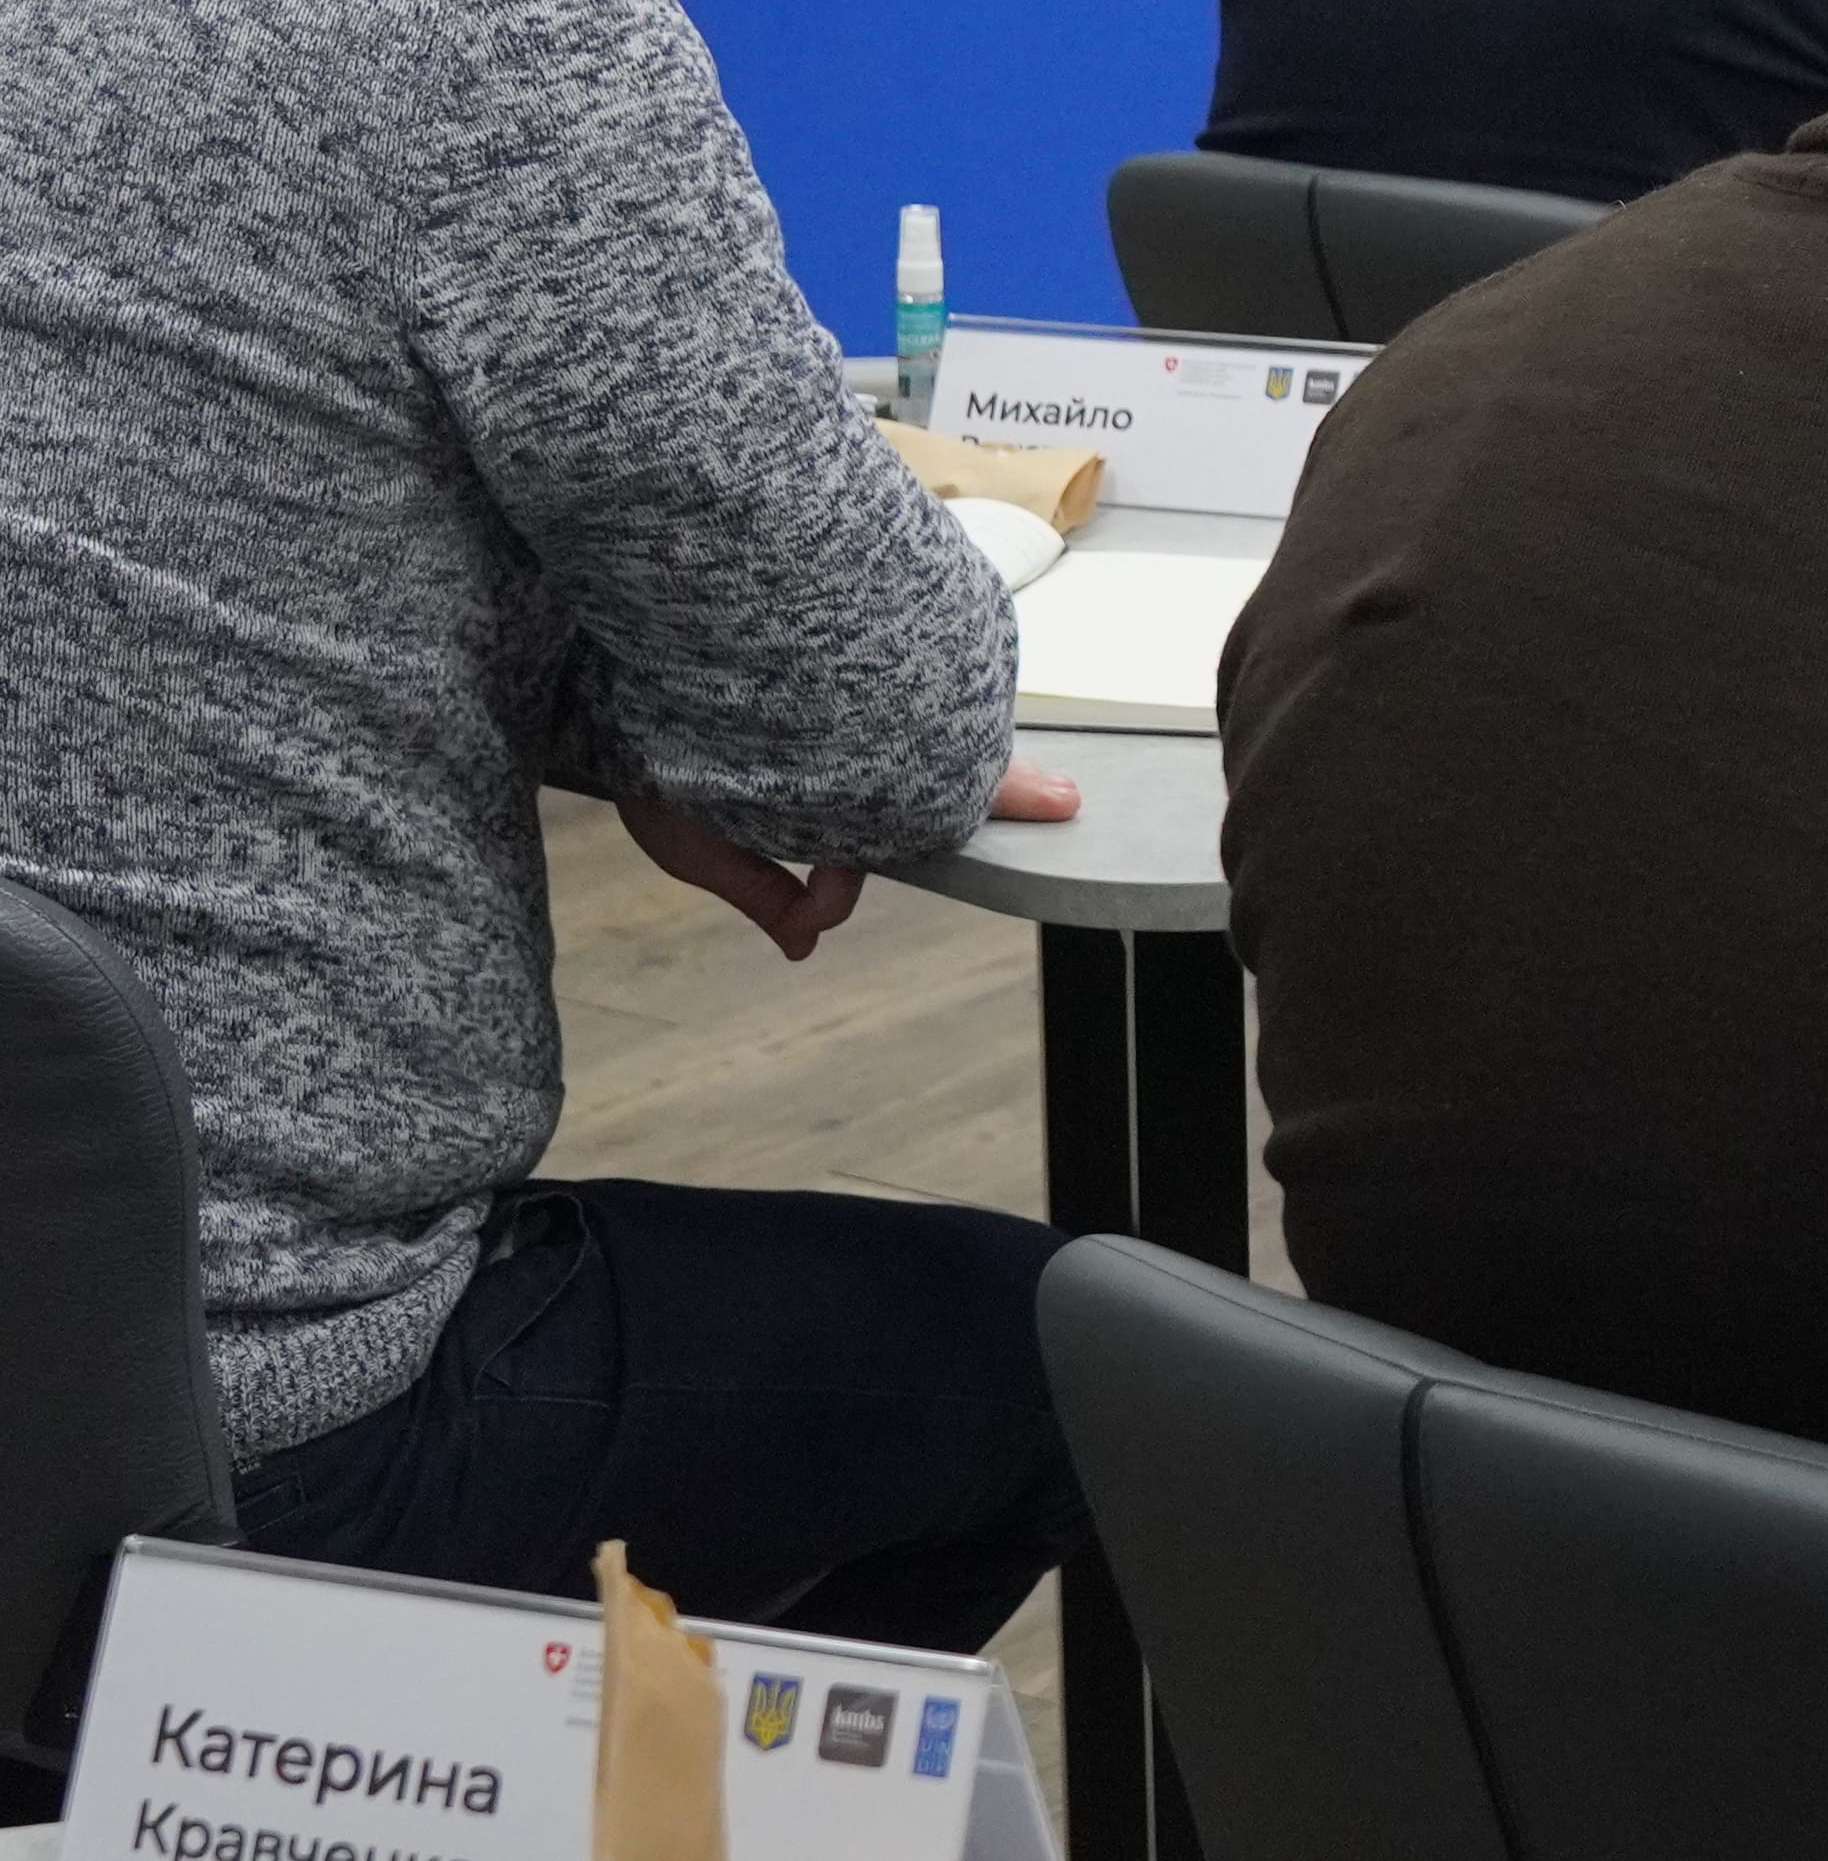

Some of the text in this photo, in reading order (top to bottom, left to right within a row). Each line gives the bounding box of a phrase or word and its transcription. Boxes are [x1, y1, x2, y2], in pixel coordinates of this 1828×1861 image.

[965, 391, 1134, 432] Михайло
[831, 1703, 886, 1732] kmbs
[151, 1703, 503, 1816] Катерина
